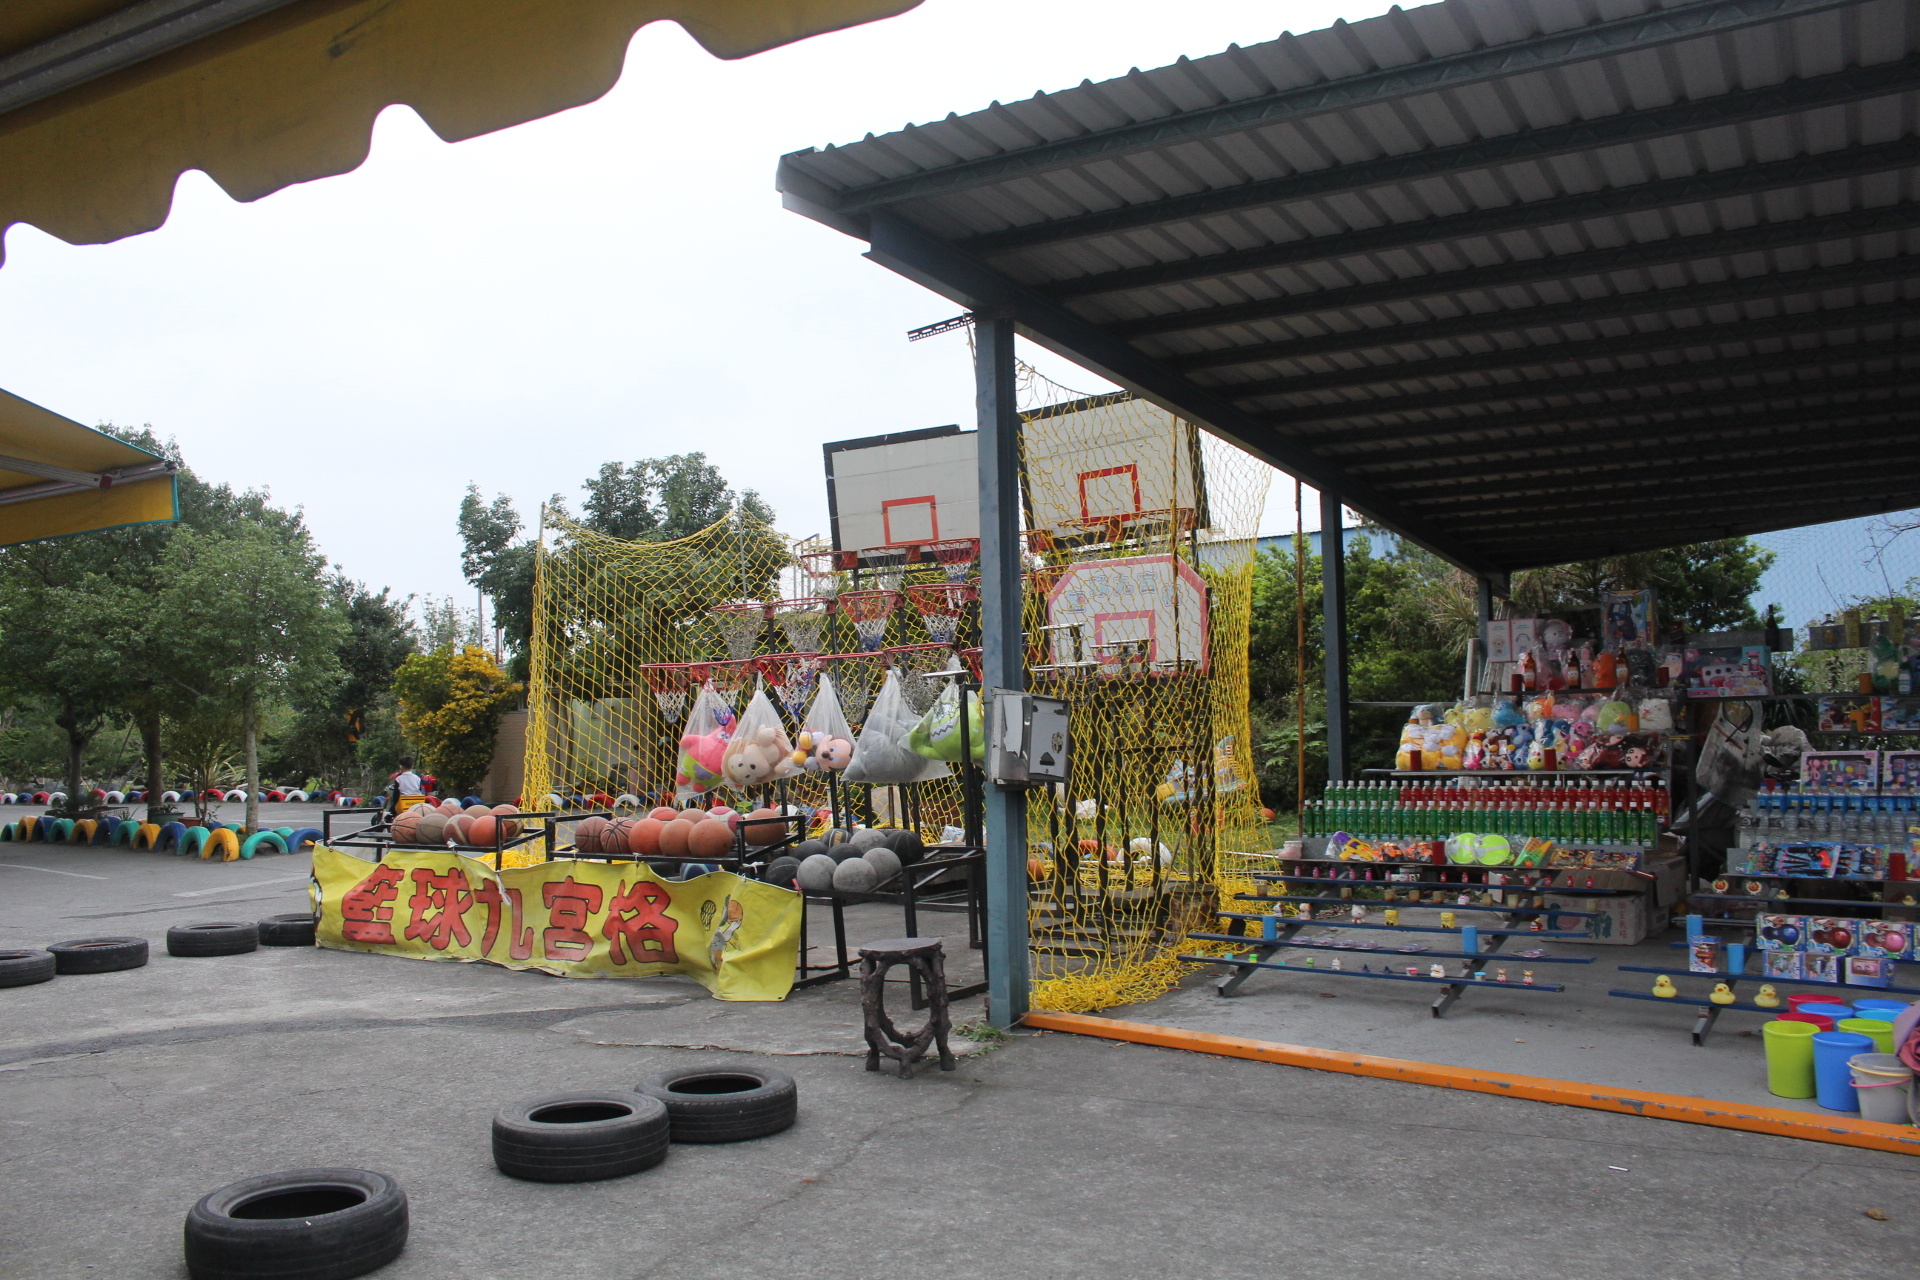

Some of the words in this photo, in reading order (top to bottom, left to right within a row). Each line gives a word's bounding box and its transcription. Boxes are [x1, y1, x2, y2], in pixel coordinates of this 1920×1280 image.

[342, 863, 679, 966] 籃球九宮格
